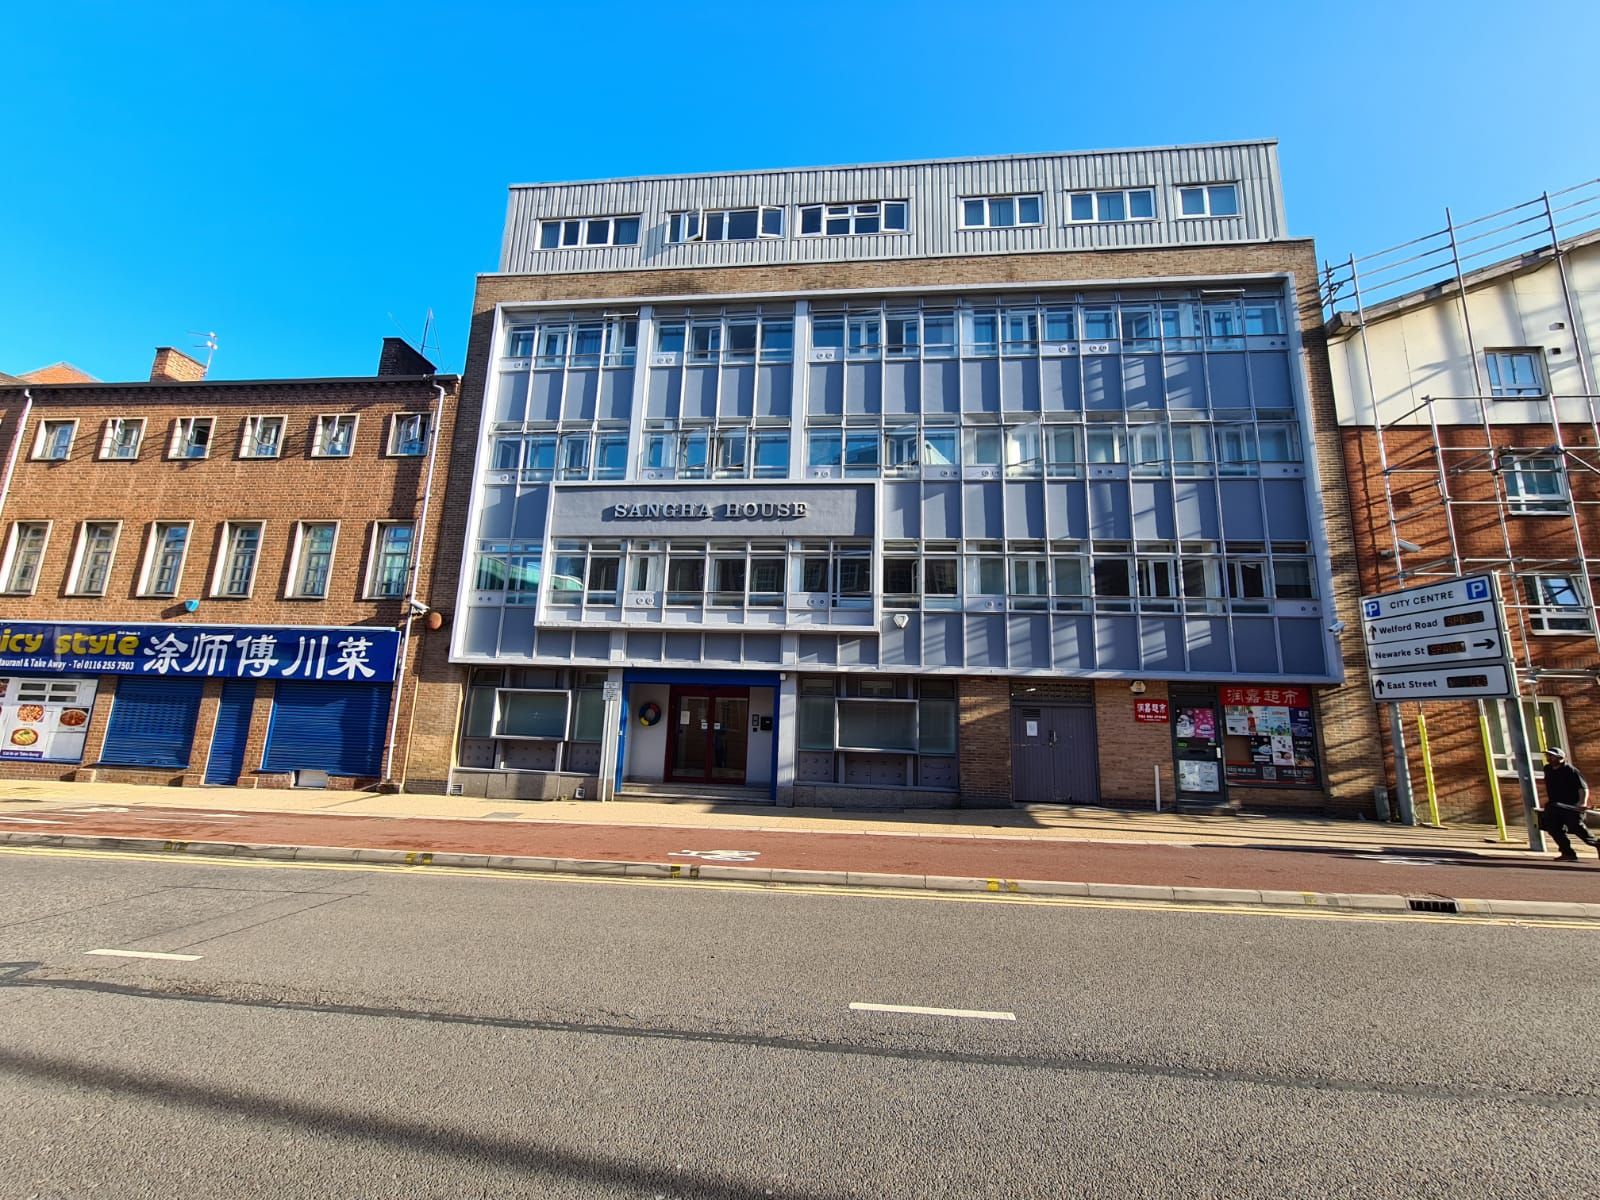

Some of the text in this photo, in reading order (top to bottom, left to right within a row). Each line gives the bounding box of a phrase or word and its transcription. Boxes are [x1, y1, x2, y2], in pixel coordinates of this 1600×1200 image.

[614, 501, 810, 518] SANGHA HOUSE
[1390, 590, 1454, 609] CITY CENTRE
[1379, 619, 1438, 634] Welford Road
[0, 628, 140, 656] icy style
[143, 632, 376, 679] 涂师傅川菜
[1375, 649, 1411, 659] Newarke
[1414, 647, 1425, 656] St
[24, 658, 29, 667] &
[30, 658, 47, 668] Take
[47, 659, 67, 671] Away
[73, 659, 84, 669] Tel
[84, 660, 102, 670] 0116
[102, 660, 116, 670] 255
[116, 661, 134, 671] 7503
[1387, 680, 1438, 690] East Street
